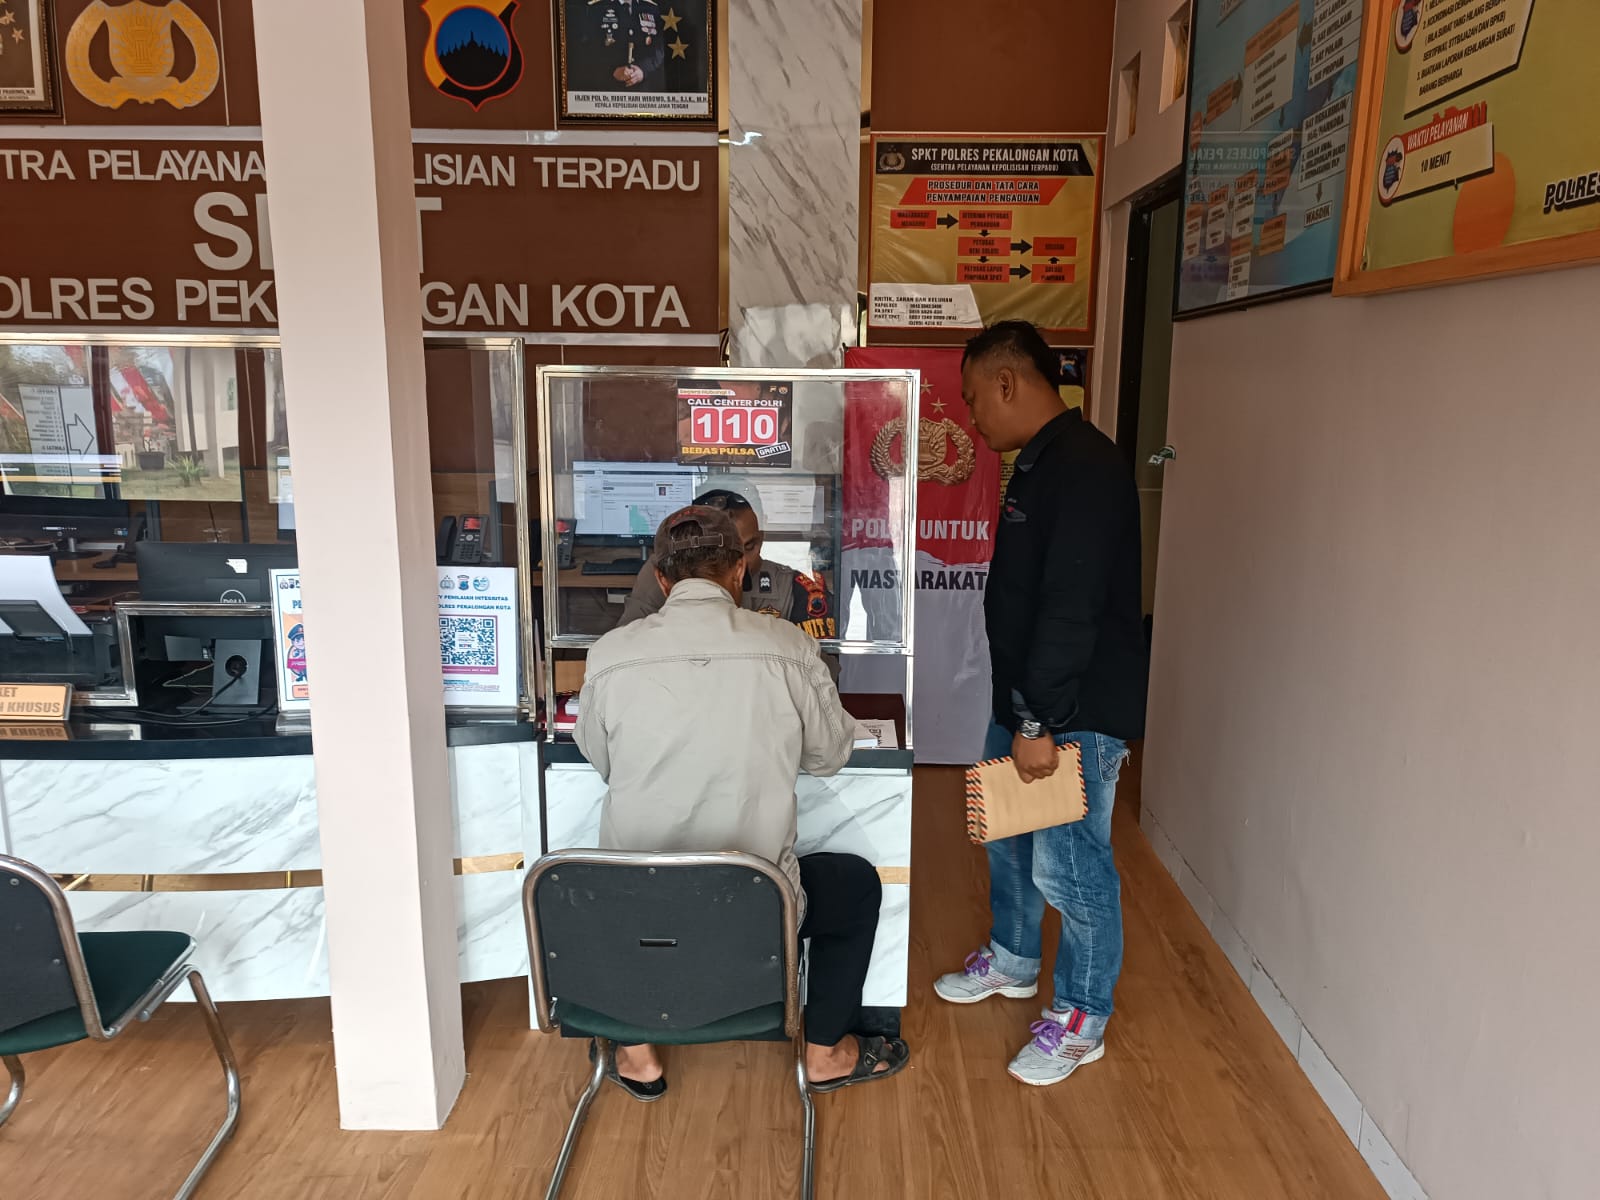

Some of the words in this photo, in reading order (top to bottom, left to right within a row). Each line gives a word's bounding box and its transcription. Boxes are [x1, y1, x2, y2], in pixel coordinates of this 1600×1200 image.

[1438, 21, 1452, 38] SURAT
[1466, 4, 1485, 22] HILANG
[1478, 18, 1489, 33] DAN
[1421, 61, 1441, 79] BUATKAN
[1441, 50, 1463, 69] LAPORAN
[1463, 33, 1496, 58] KEHILANGAN
[1418, 80, 1437, 97] BARANG
[1407, 127, 1430, 151] WAKTU
[1429, 111, 1469, 142] PELAYANAN
[911, 148, 938, 160] SPKT
[940, 148, 979, 161] POLRES
[982, 148, 1049, 162] PEKALONGAN
[1052, 149, 1079, 162] KOTA
[1420, 158, 1429, 173] 10
[1429, 150, 1452, 171] MENIT
[88, 150, 268, 182] PELAYANA
[533, 156, 700, 192] TERPADU
[956, 163, 990, 172] PELAYANAN
[928, 180, 972, 190] PROSEDUR
[974, 181, 993, 190] DAN
[994, 181, 1015, 190] TATA
[1017, 181, 1040, 190] CARA
[1544, 172, 1600, 210] POLRE
[926, 192, 986, 202] PENYAMPAIAN
[989, 193, 1040, 203] PENGADUAN
[551, 283, 691, 328] KOTA
[687, 398, 713, 406] CALL
[714, 399, 752, 407] CENTER
[753, 399, 783, 407] POLRI
[696, 412, 774, 440] 110
[681, 446, 718, 455] BEBAS
[719, 447, 756, 456] PULSA
[759, 444, 787, 456] GRATIS
[919, 519, 991, 541] UNTUK
[850, 568, 988, 591] MASRAKAT
[7, 701, 61, 713] KHUSUS
